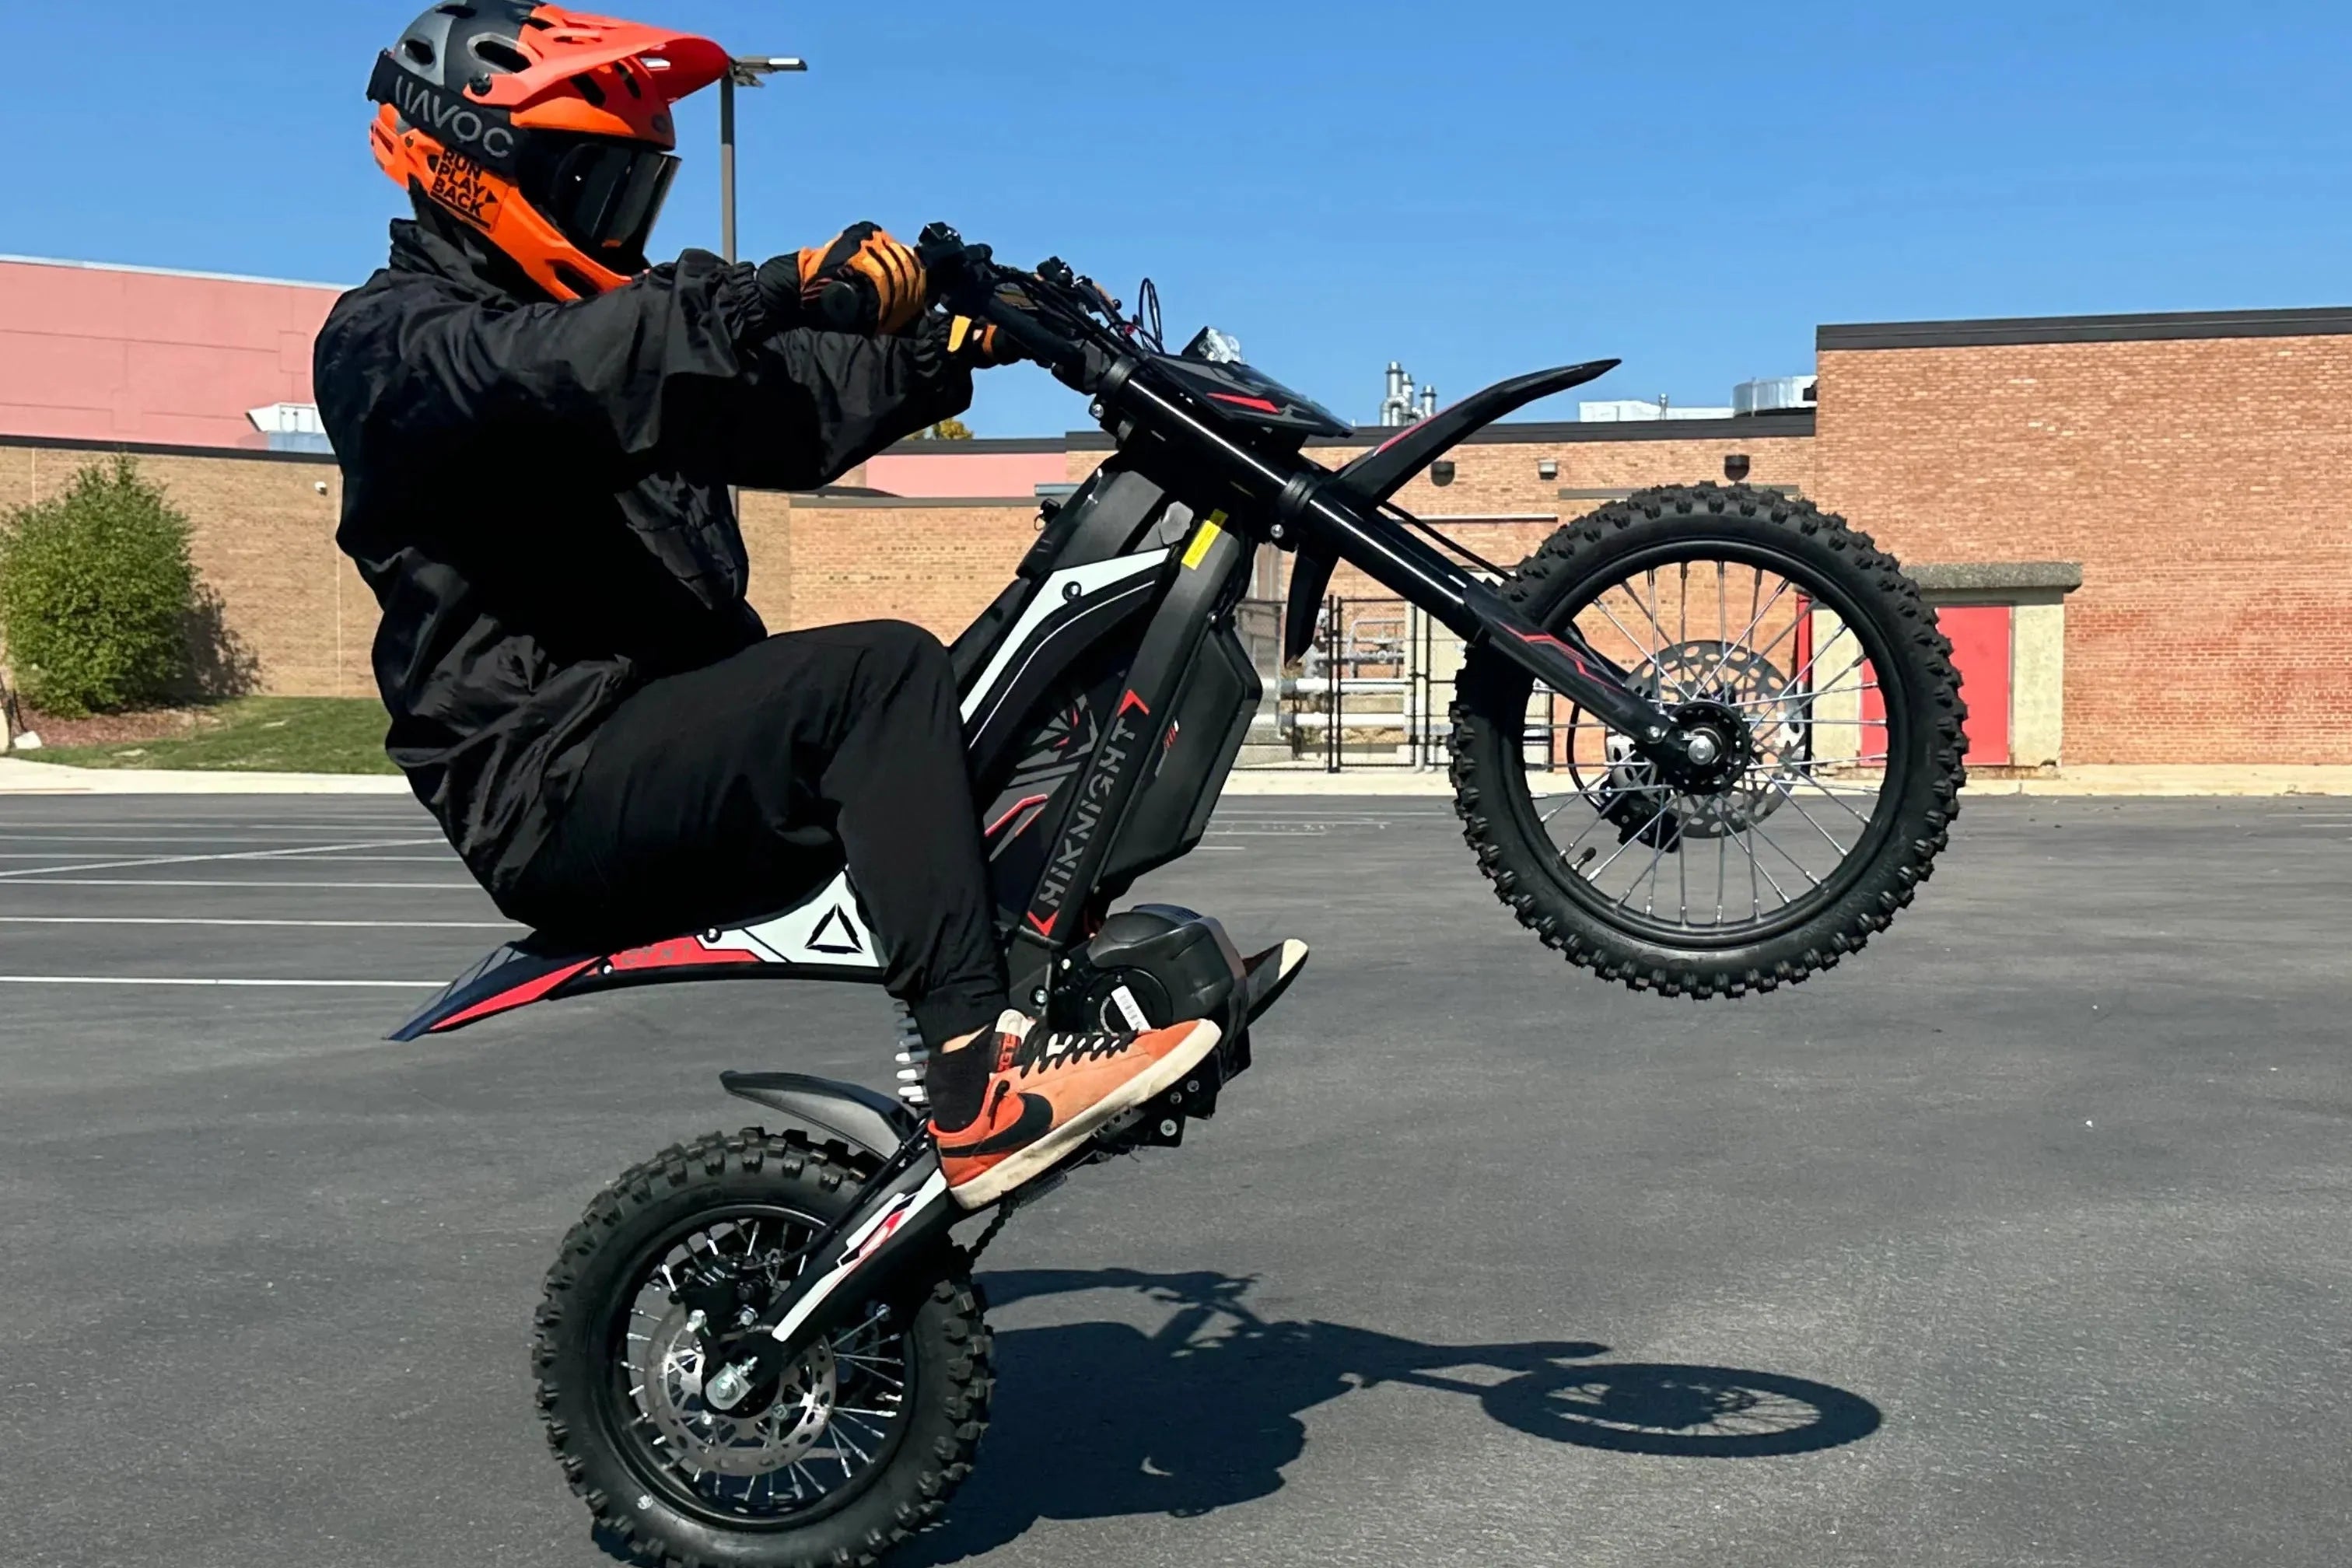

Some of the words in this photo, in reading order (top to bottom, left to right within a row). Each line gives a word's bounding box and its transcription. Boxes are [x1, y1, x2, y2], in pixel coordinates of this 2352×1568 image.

[437, 162, 486, 194] PLAY
[440, 149, 483, 180] RUN
[431, 177, 485, 217] BACK
[1038, 717, 1136, 908] HIKNIGHT
